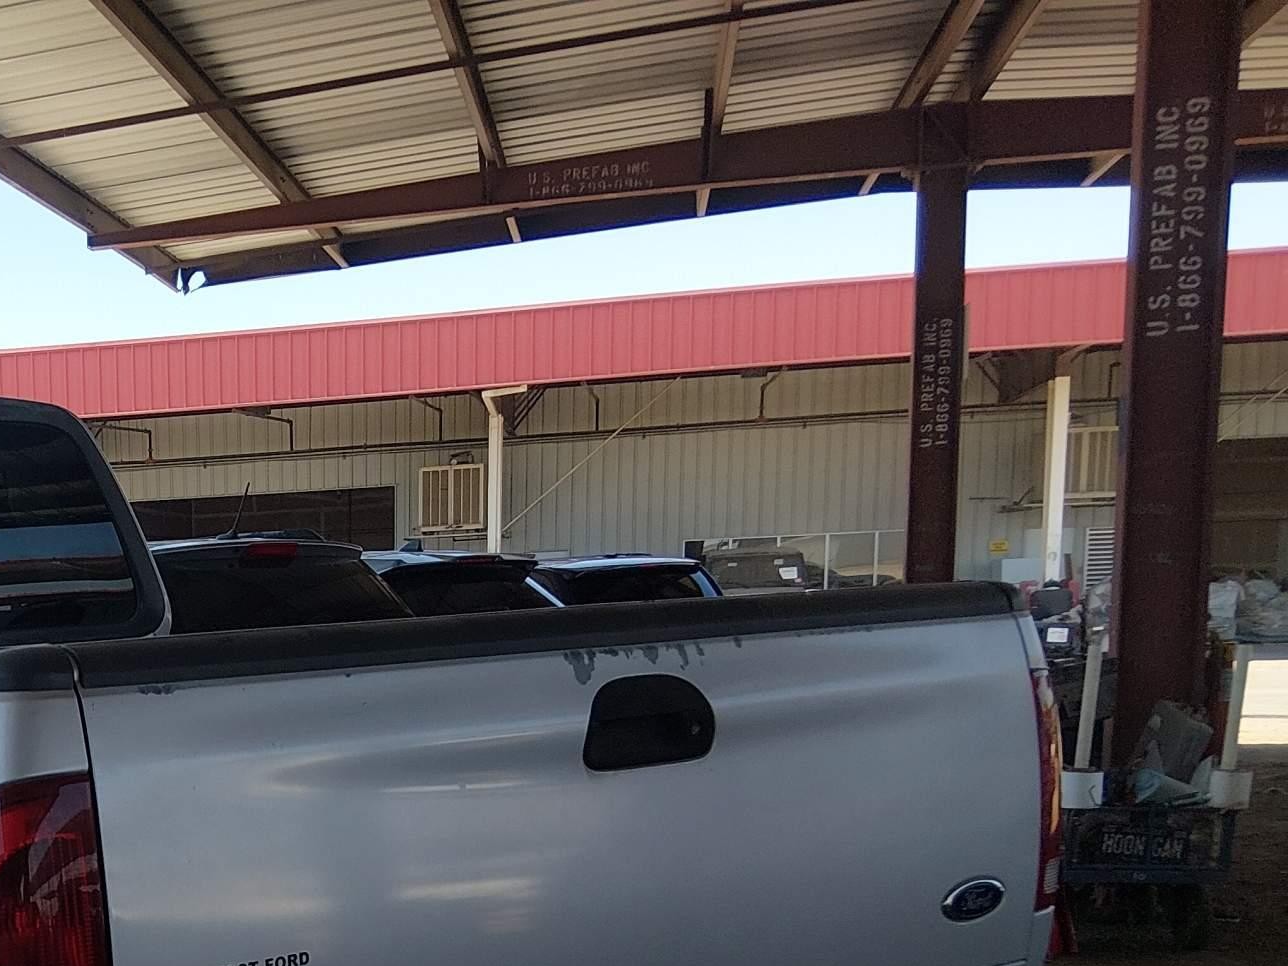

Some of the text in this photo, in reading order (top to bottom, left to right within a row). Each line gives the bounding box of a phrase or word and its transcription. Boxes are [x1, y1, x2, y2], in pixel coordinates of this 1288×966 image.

[563, 165, 619, 181] PREFAB
[1146, 105, 1181, 337] U.S. PREFAB INC
[1176, 97, 1211, 332] 1-866-799-0969
[920, 354, 935, 411] PREFAB
[935, 319, 953, 447] 1-866-799-0969
